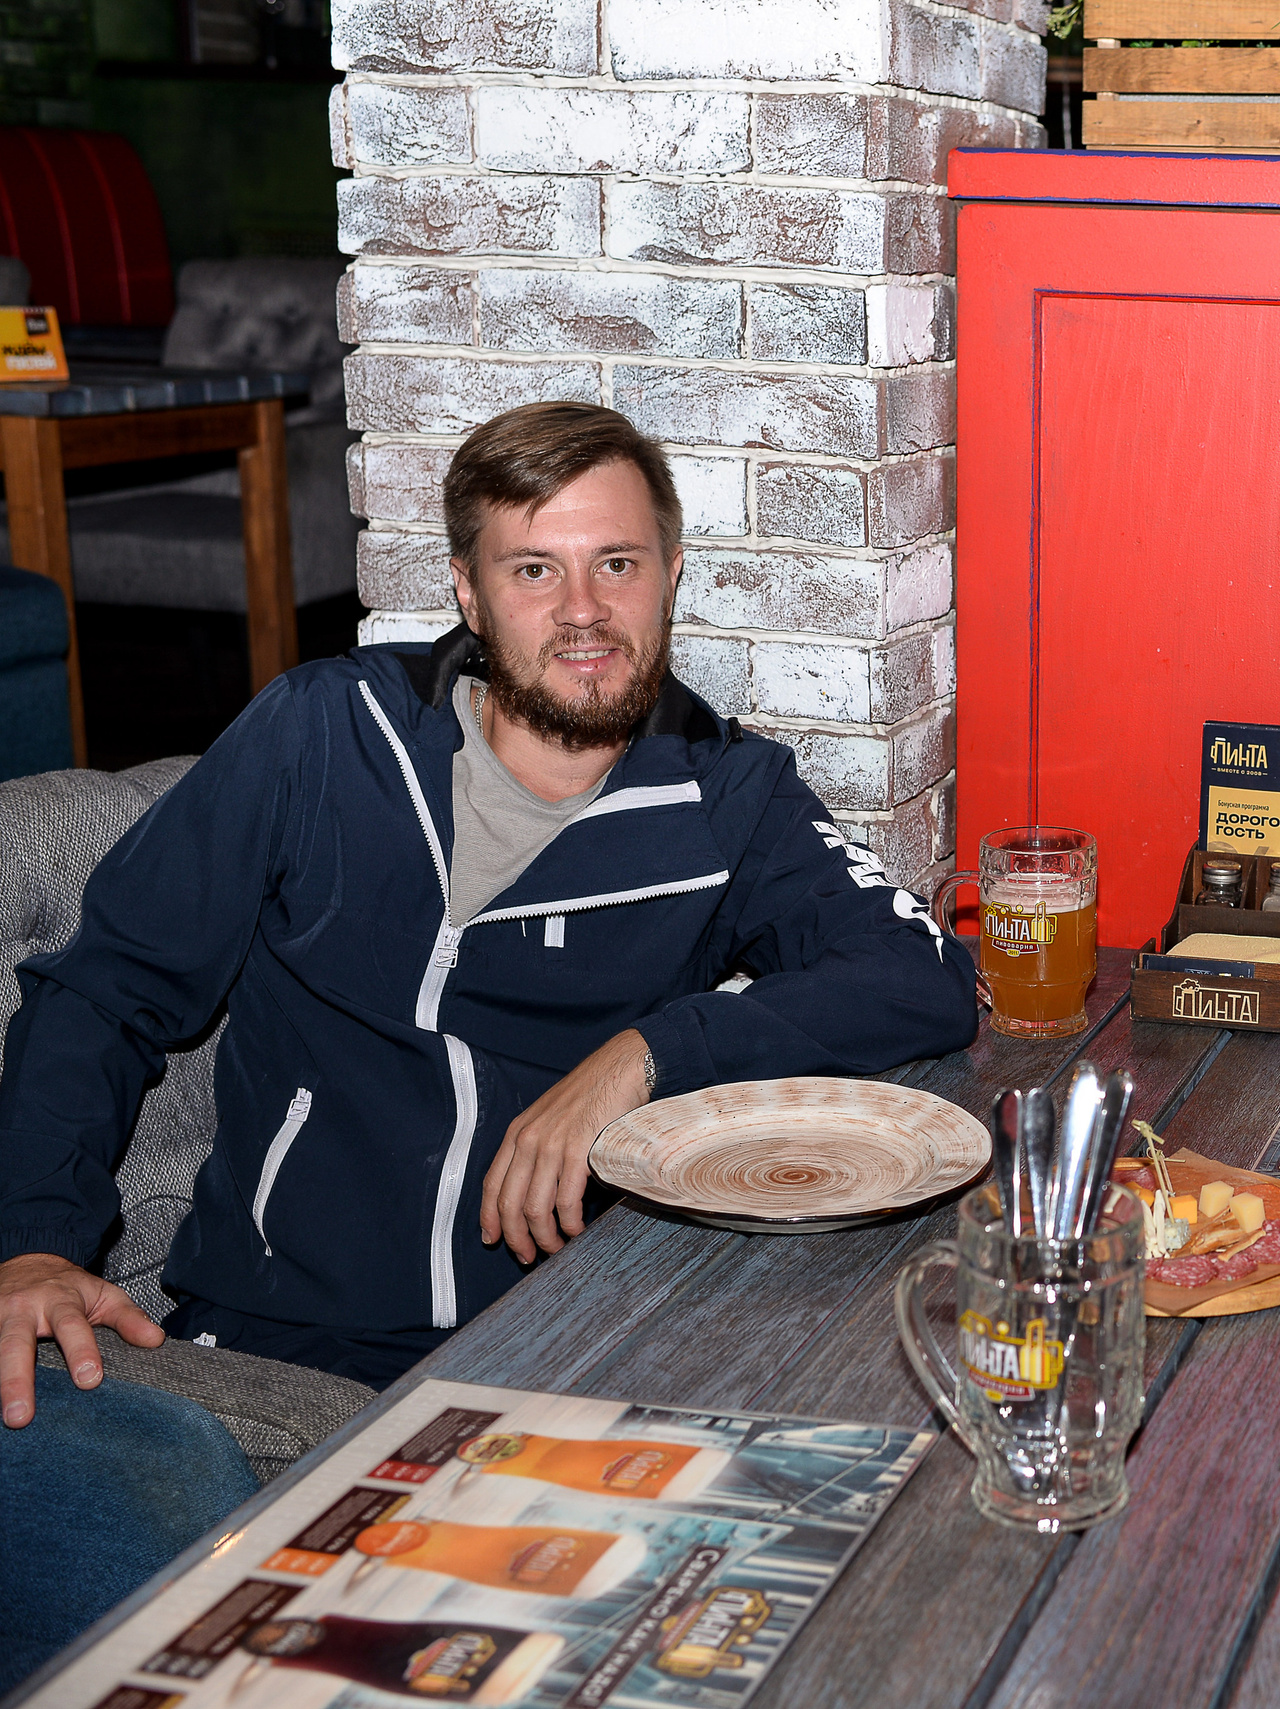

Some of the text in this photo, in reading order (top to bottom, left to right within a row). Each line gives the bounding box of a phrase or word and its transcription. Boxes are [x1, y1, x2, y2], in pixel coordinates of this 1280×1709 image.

[1210, 737, 1268, 769] ПИНТА
[1216, 767, 1240, 775] ВМЕСТЕ
[1218, 799, 1270, 811] Бонусная программа
[1216, 825, 1265, 839] ГОСТЬ
[985, 913, 1031, 941] ПИНТА
[1175, 985, 1254, 1022] ПИНТА
